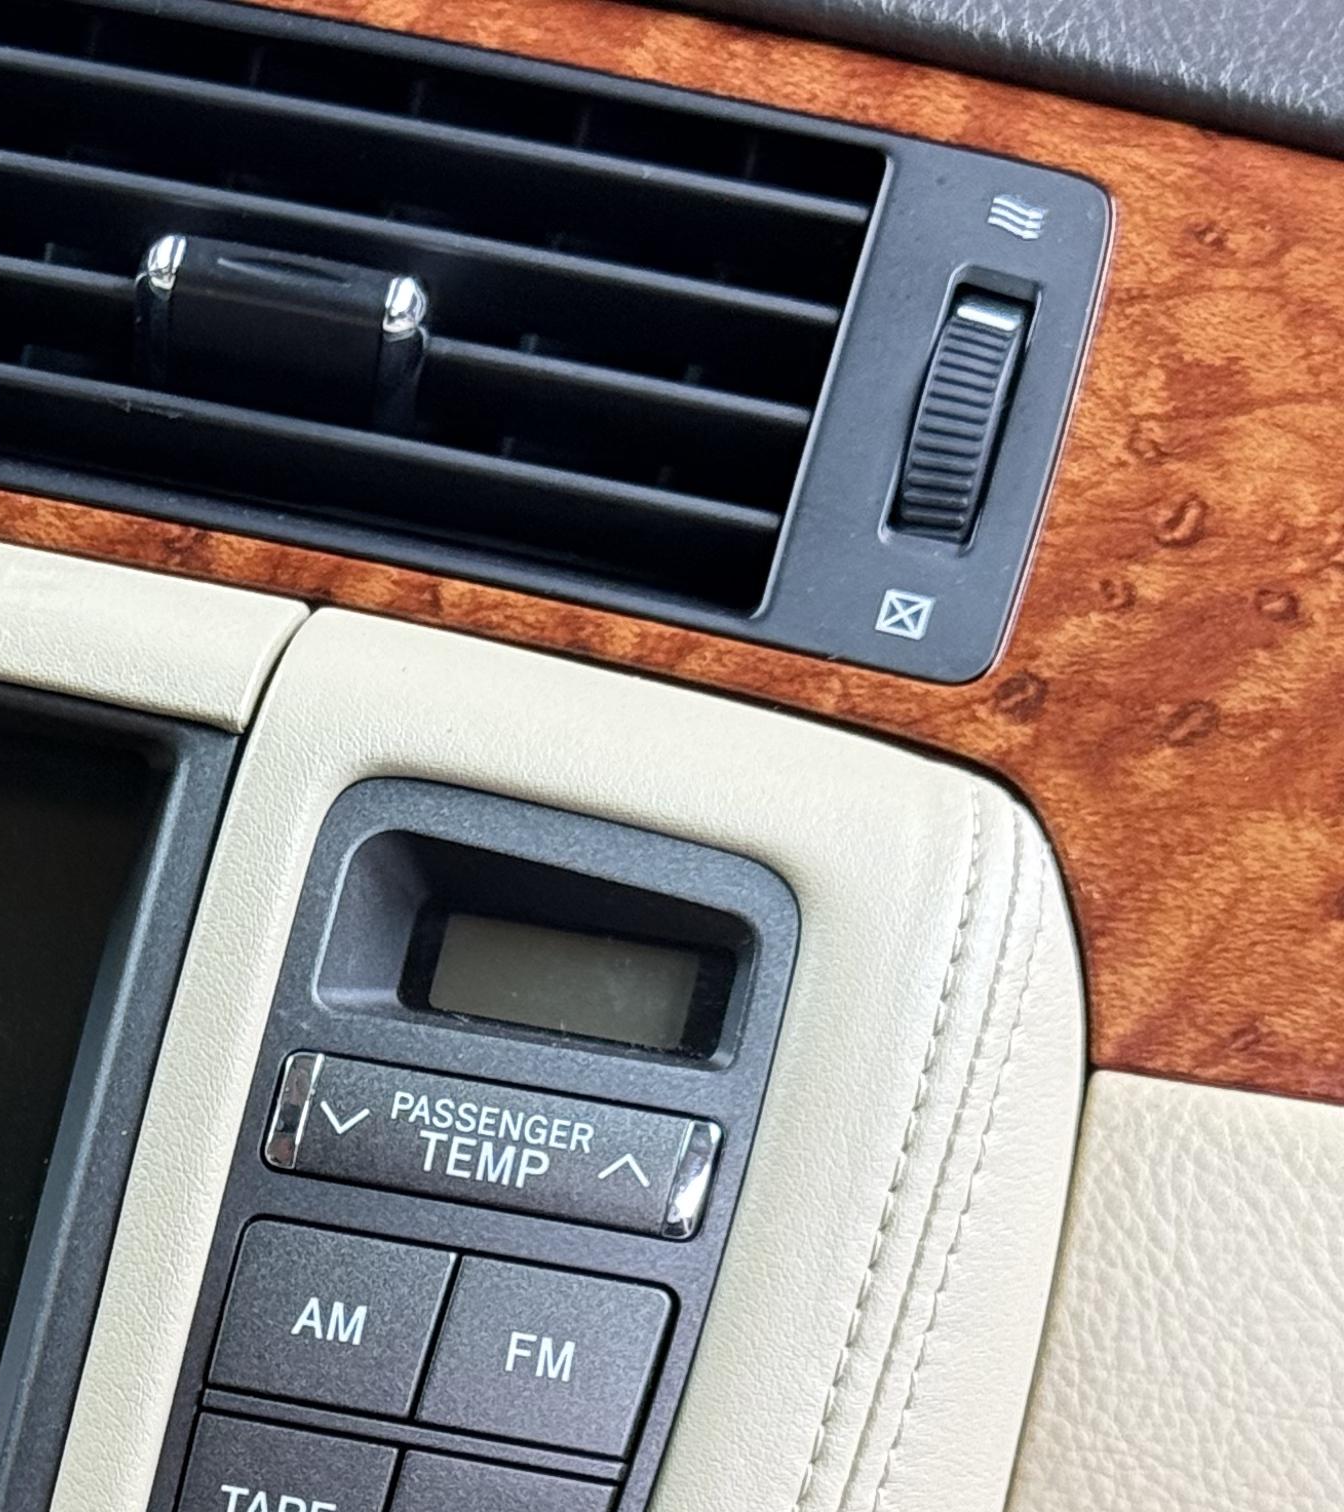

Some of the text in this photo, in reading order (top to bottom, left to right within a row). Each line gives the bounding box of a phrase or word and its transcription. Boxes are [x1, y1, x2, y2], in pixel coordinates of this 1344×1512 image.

[389, 1090, 595, 1153] PASSENGER
[418, 1129, 551, 1189] TEMP
[290, 1296, 368, 1346] AM
[504, 1331, 576, 1382] FM
